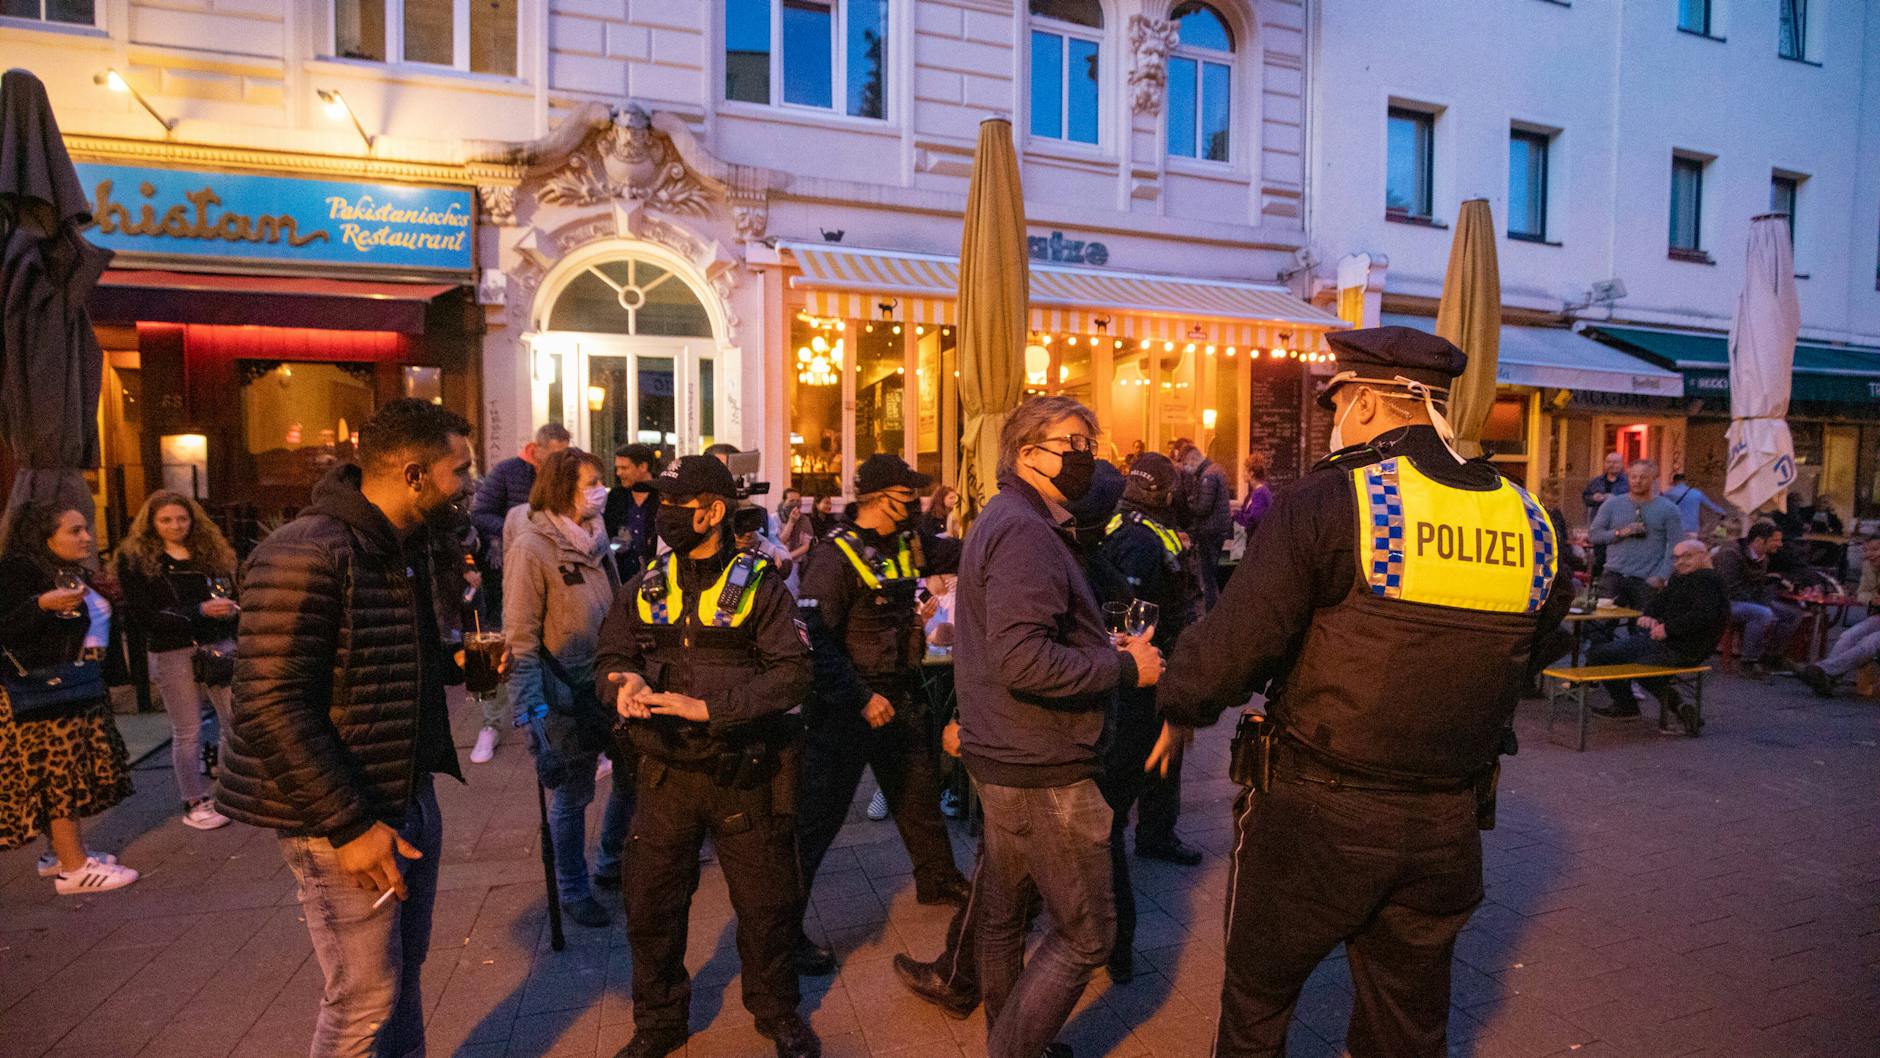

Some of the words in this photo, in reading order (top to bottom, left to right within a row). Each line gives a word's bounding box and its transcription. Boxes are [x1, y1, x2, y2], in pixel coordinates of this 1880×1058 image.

[88, 180, 329, 247] histan
[339, 223, 466, 252] Restaurant
[1027, 231, 1109, 266] atze
[1417, 521, 1525, 568] POLIZEI
